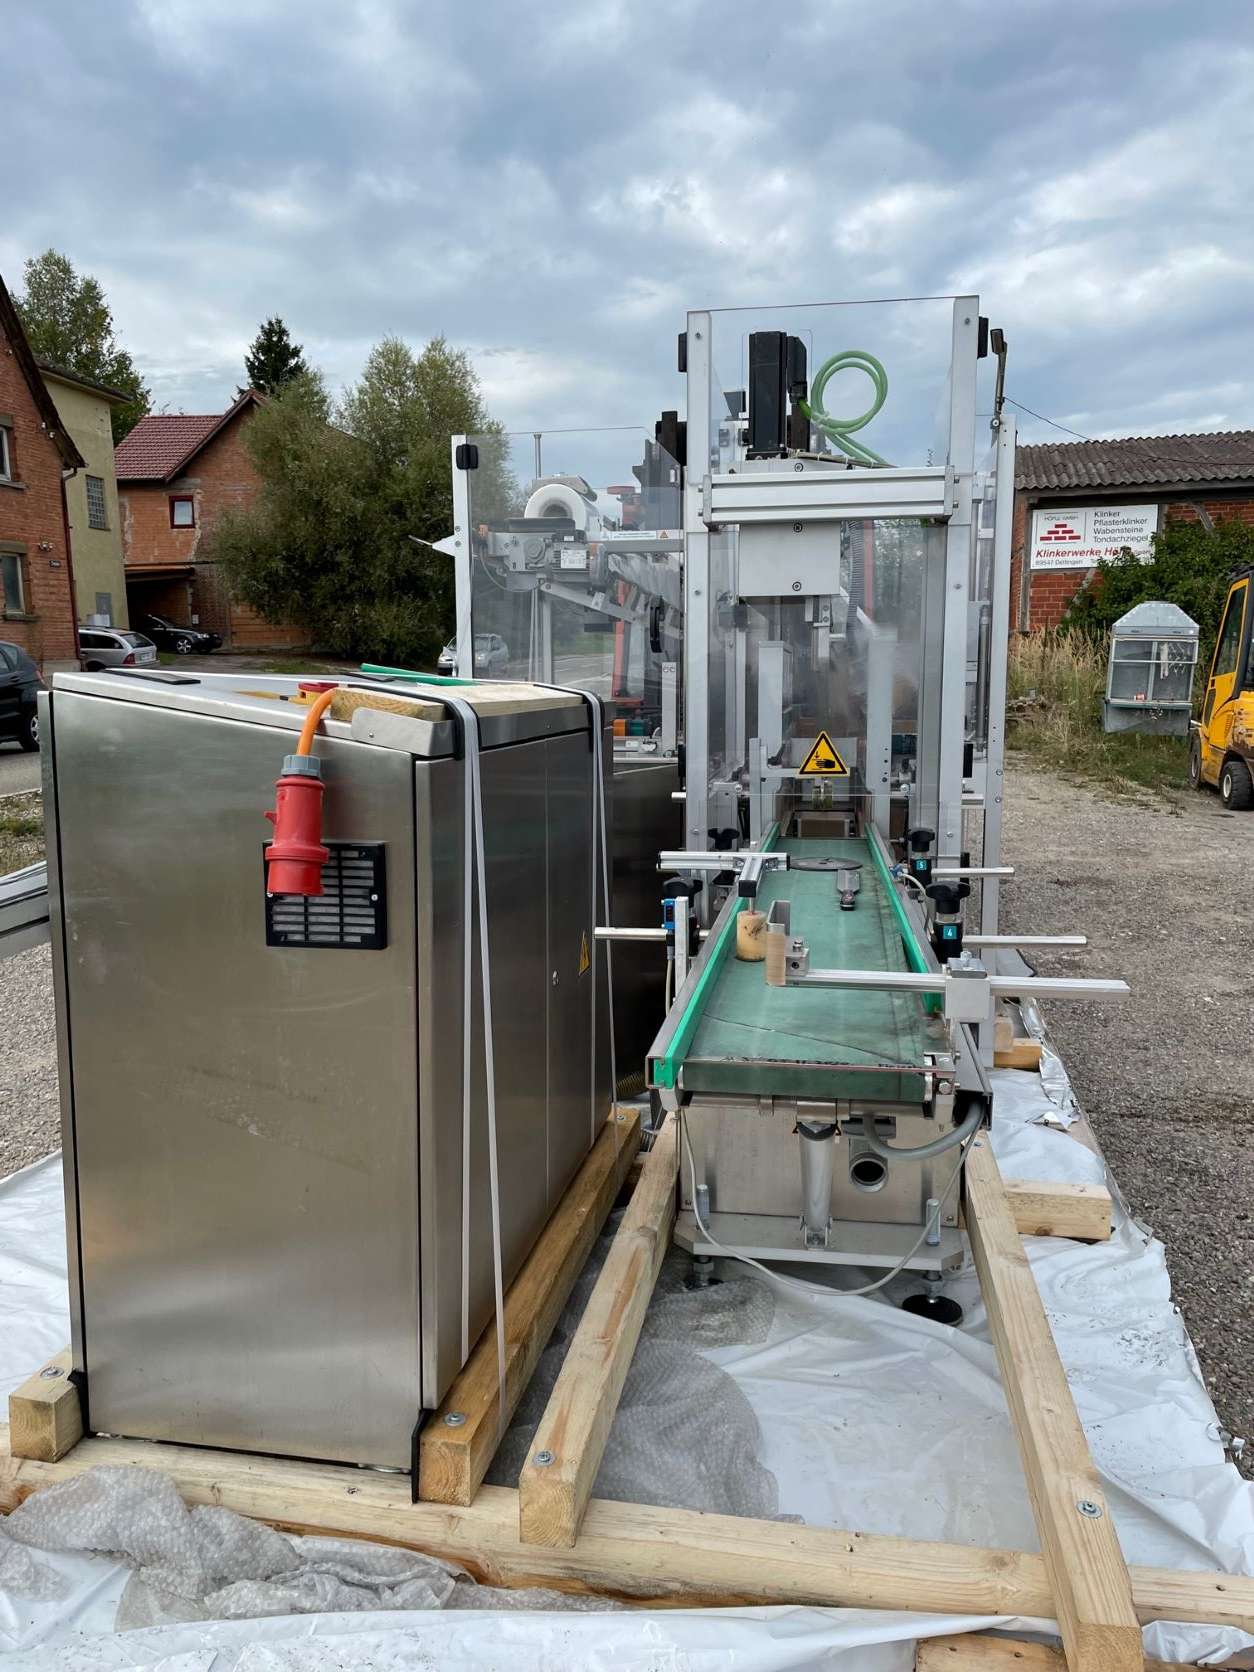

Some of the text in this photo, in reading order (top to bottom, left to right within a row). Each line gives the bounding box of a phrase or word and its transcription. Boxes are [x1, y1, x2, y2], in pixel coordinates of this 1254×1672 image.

[1094, 518, 1147, 526] Pflasterklinker
[1094, 526, 1144, 535] Wabensteine
[1094, 534, 1149, 543] Tondachziegel
[1036, 549, 1101, 558] Klinkerwerke
